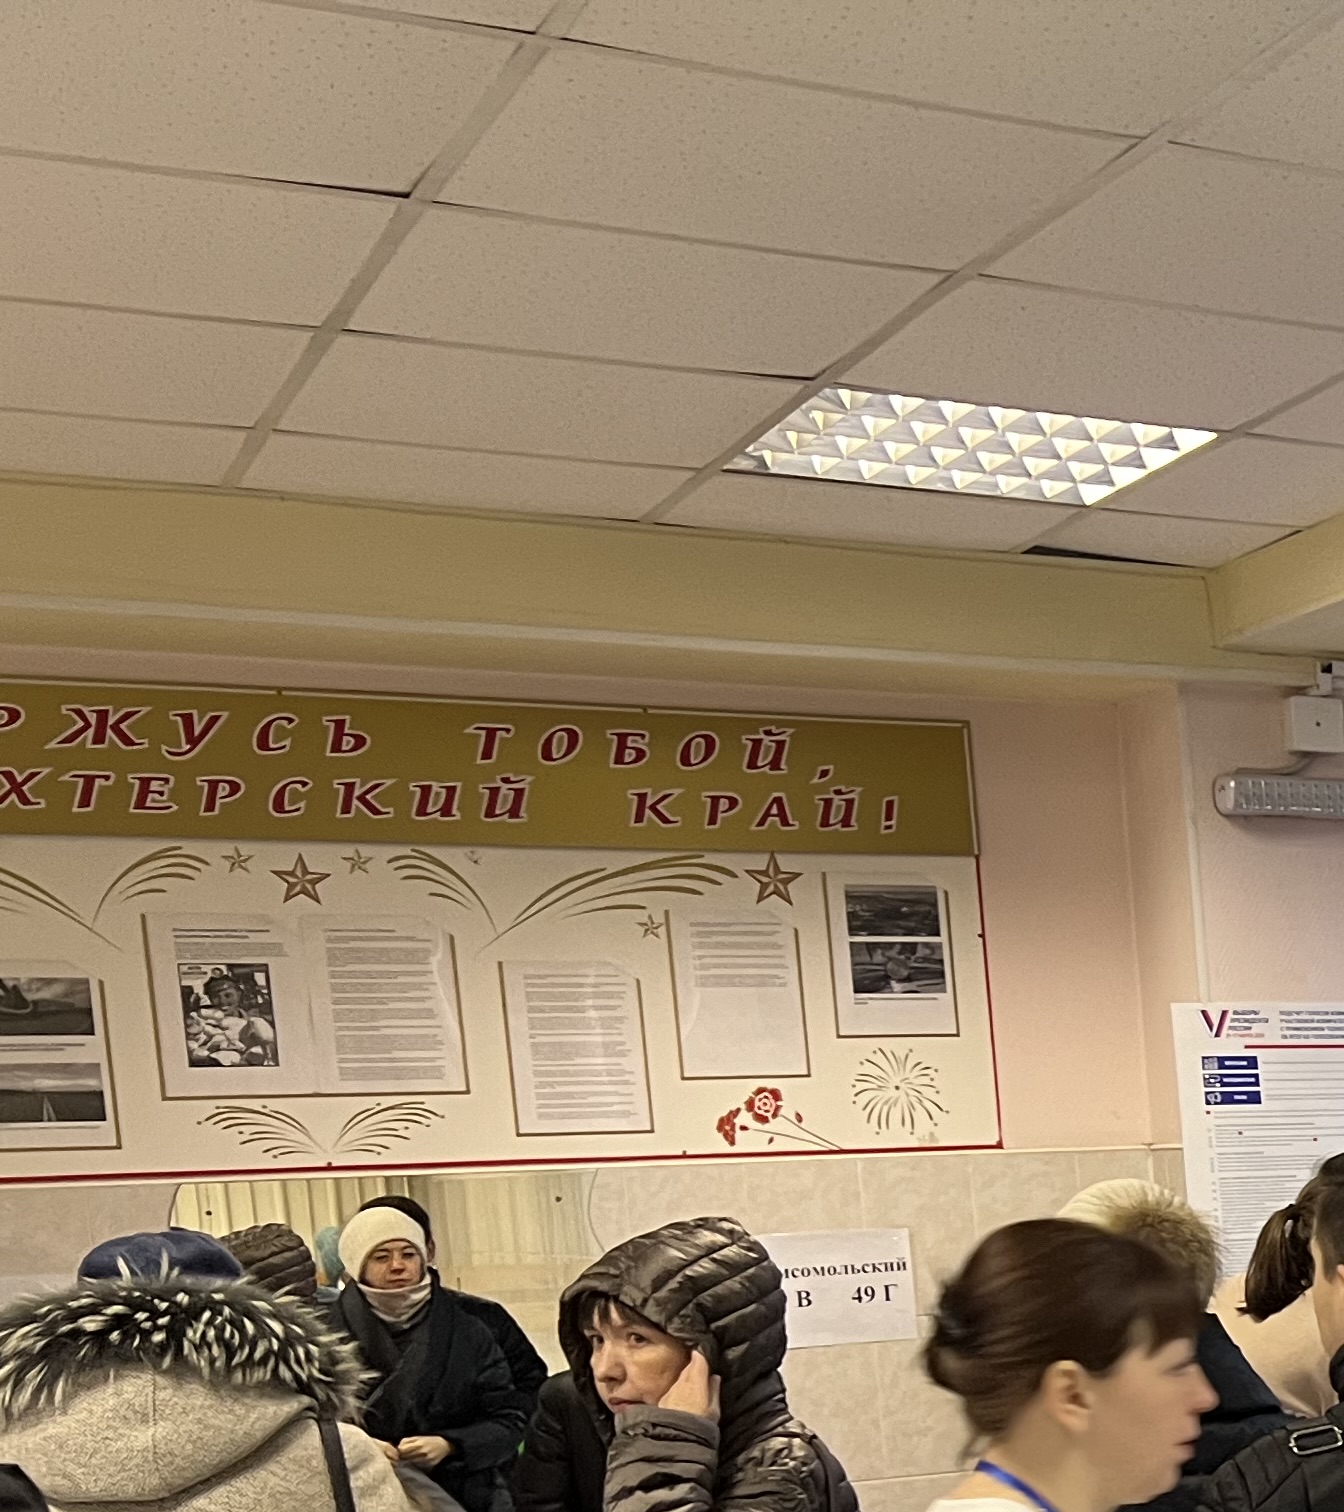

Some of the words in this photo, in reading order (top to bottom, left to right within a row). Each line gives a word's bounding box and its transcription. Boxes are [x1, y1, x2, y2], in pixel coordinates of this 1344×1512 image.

[464, 723, 834, 784] ТОБОЙ,
[0, 766, 534, 822] ХТЕРСКИЙ
[628, 786, 899, 834] КРАЙ!
[796, 1290, 813, 1308] В
[852, 1285, 876, 1303] 49
[884, 1284, 899, 1302] Г
